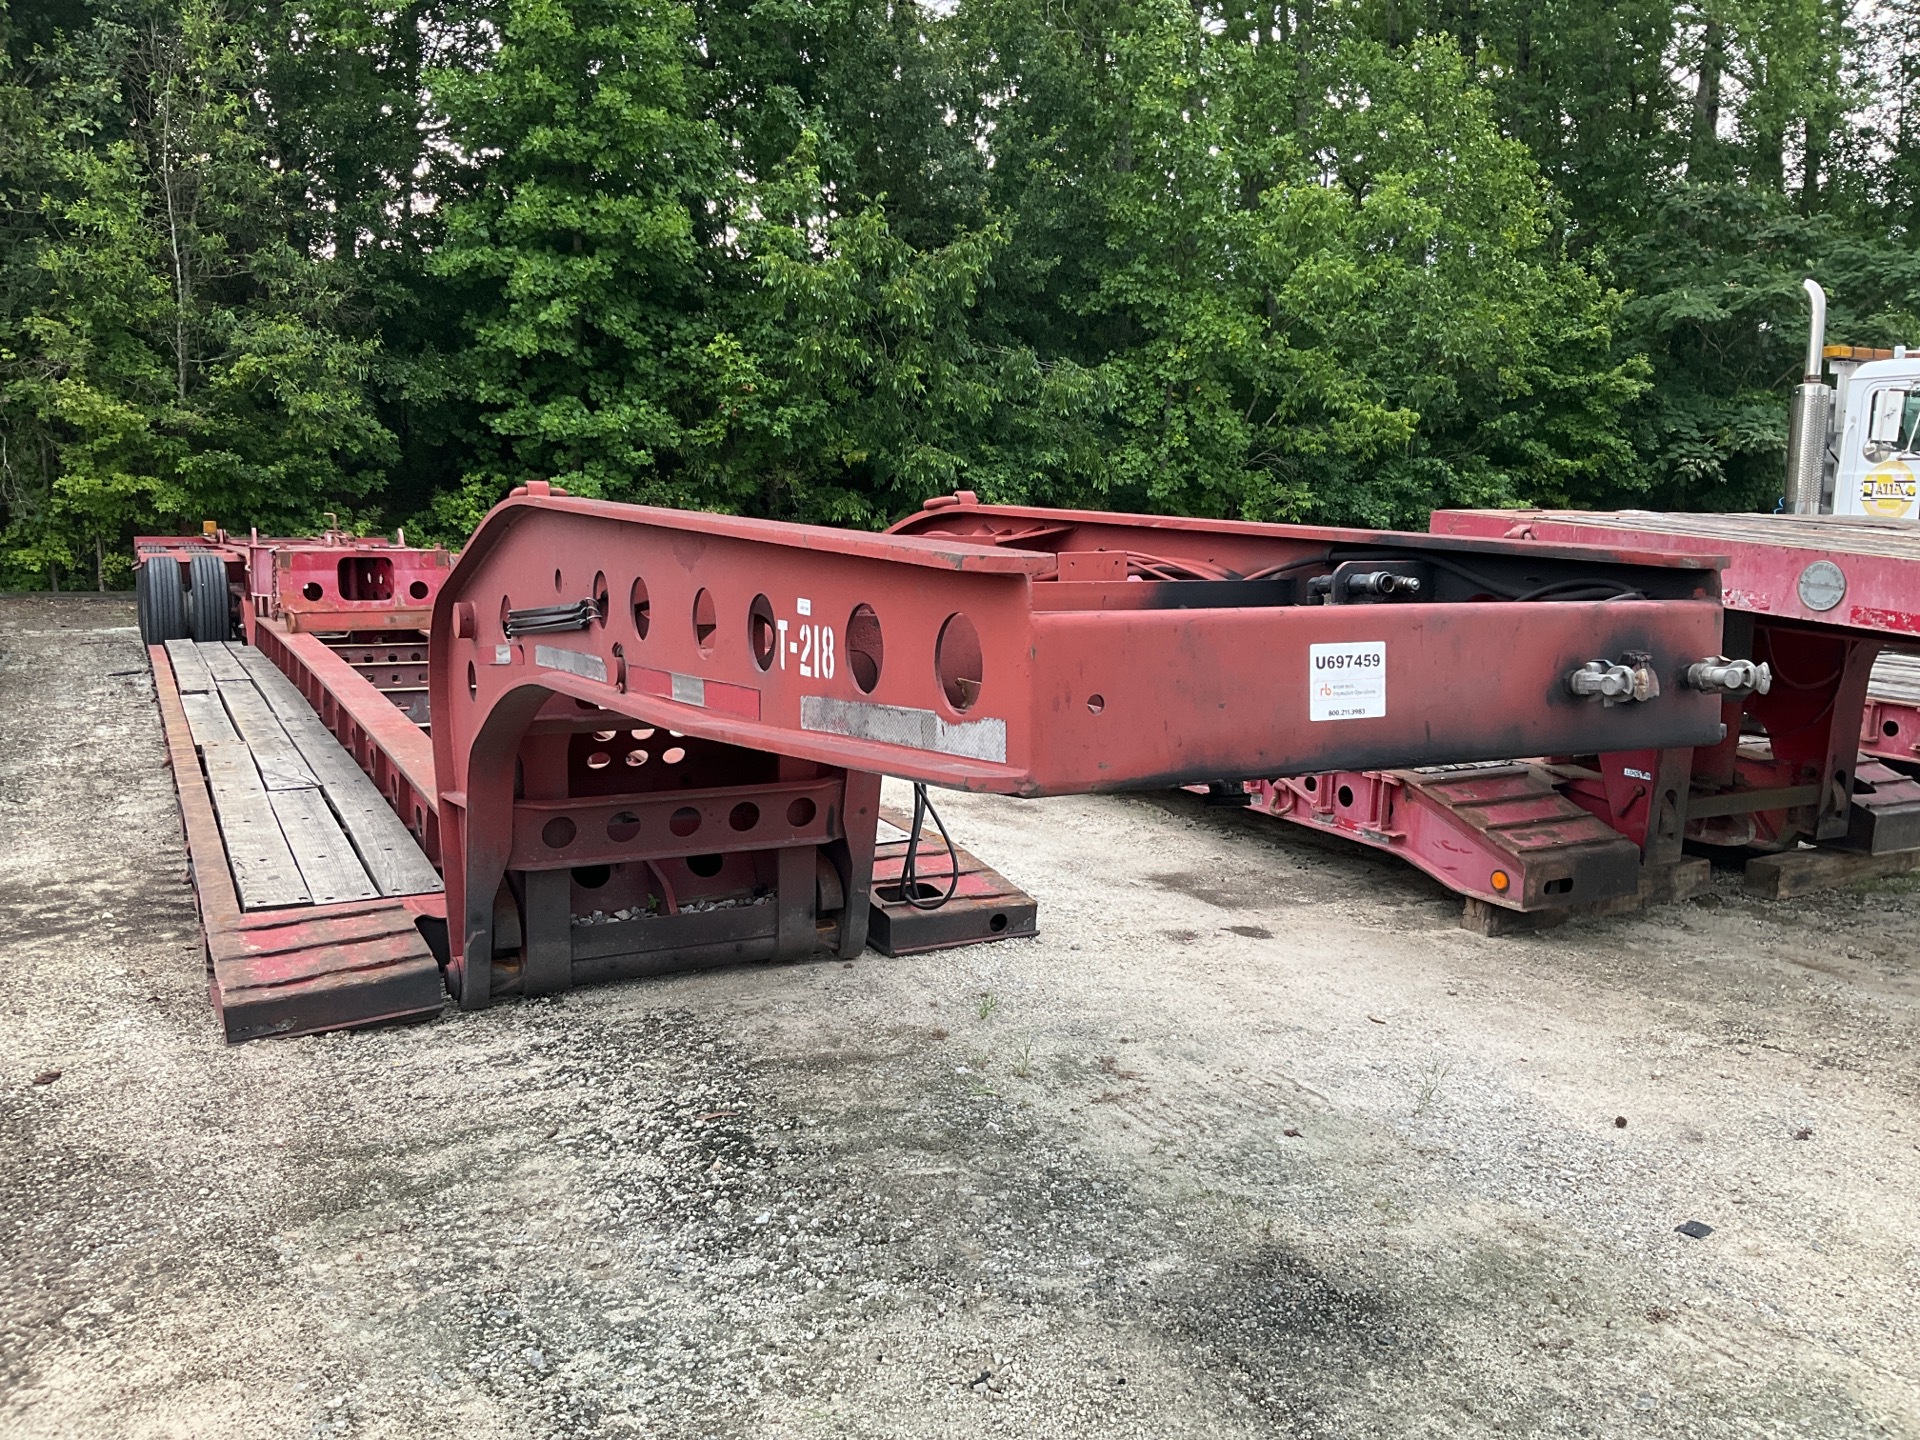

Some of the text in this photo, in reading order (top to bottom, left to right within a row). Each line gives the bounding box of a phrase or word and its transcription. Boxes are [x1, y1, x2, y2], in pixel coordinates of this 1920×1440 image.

[777, 619, 835, 679] T-218
[1315, 653, 1381, 670] U697459
[1328, 708, 1366, 717] 800.211.3983
